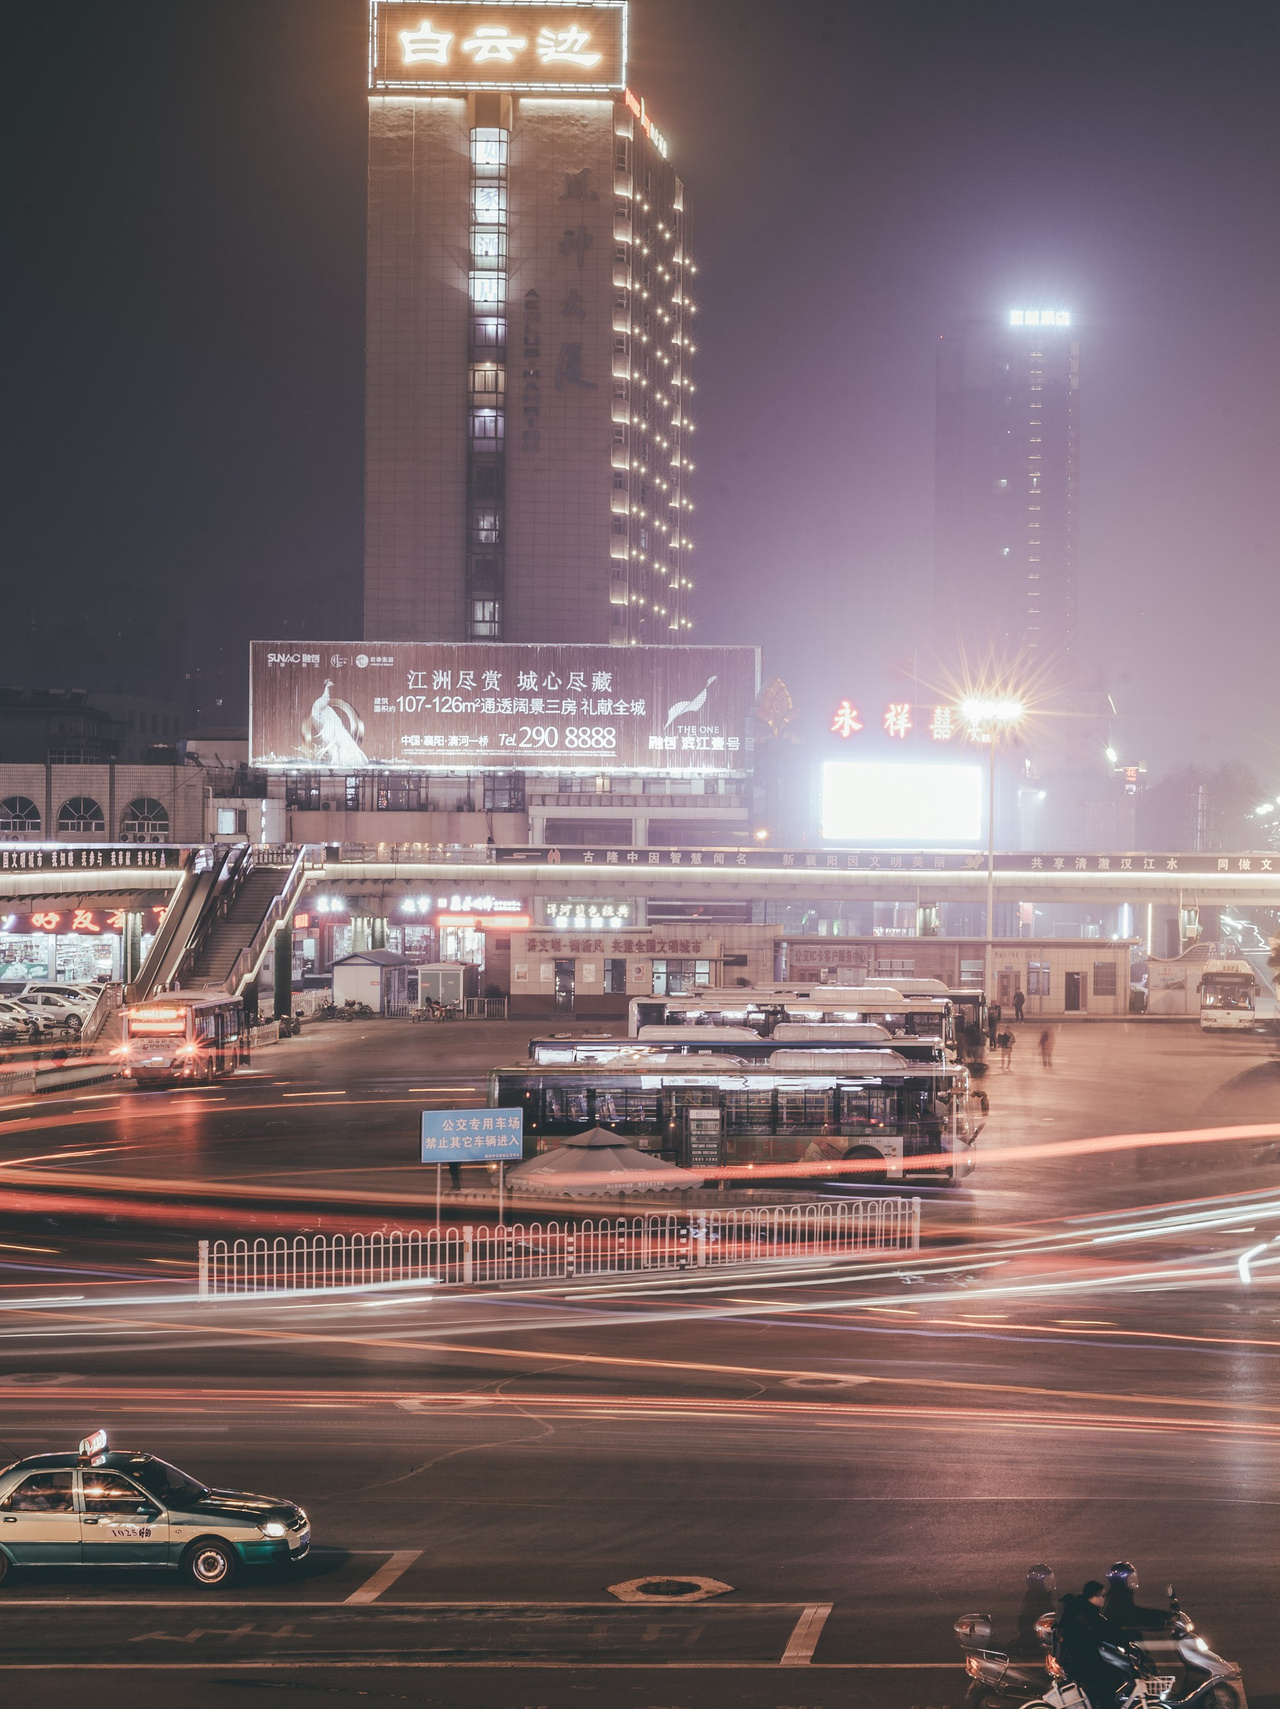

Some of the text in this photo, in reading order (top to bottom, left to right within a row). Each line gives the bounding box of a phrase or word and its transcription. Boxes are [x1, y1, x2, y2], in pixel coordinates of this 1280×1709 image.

[399, 20, 602, 69] 白云边
[267, 653, 300, 662] SUNAC
[407, 669, 613, 693] 江洲尽赏 城心尽藏
[581, 699, 646, 716] 礼献全城
[519, 726, 559, 748] 290
[565, 726, 616, 748] 8888
[678, 725, 719, 734] THE ONE
[681, 736, 741, 751] 滨江壹号
[3, 851, 43, 869] 国文明城市
[583, 850, 747, 865] 古隆中因智慧闻名
[782, 853, 945, 868] 新襄阳因文明美丽
[1031, 857, 1178, 870] 共享清澈汉江水
[547, 903, 629, 918] 洋河蓝色经典
[612, 938, 702, 954] 共建全国文明城市
[795, 949, 867, 963] 公交IC卡客户服务中心
[442, 1116, 520, 1131] 公交专用车场
[425, 1134, 520, 1150] 禁止其它车辆进入
